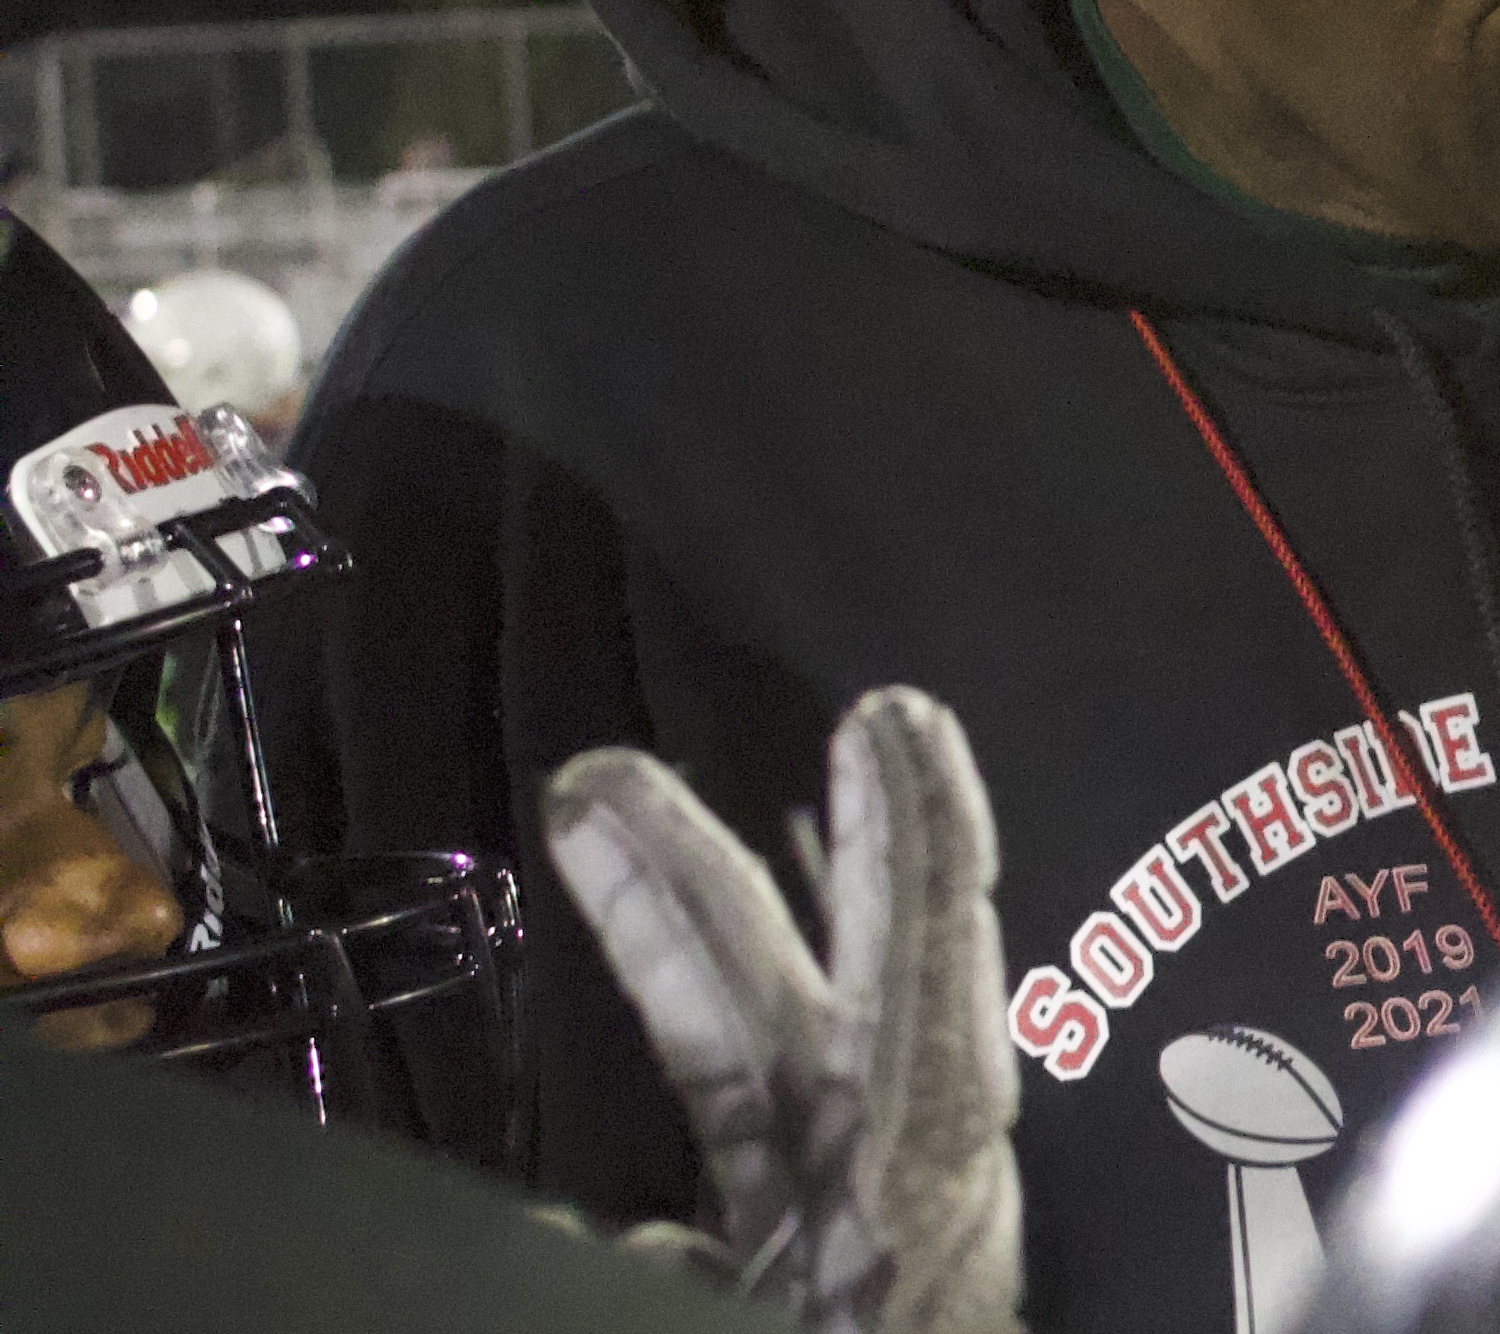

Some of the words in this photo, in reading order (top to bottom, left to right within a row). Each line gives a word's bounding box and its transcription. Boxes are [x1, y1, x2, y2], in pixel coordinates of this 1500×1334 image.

[84, 413, 214, 496] Riddel
[1008, 692, 1497, 1082] SOUTHSIDE
[1313, 864, 1429, 926] AYF
[1325, 924, 1475, 988] 2019
[1344, 984, 1483, 1050] 2021
